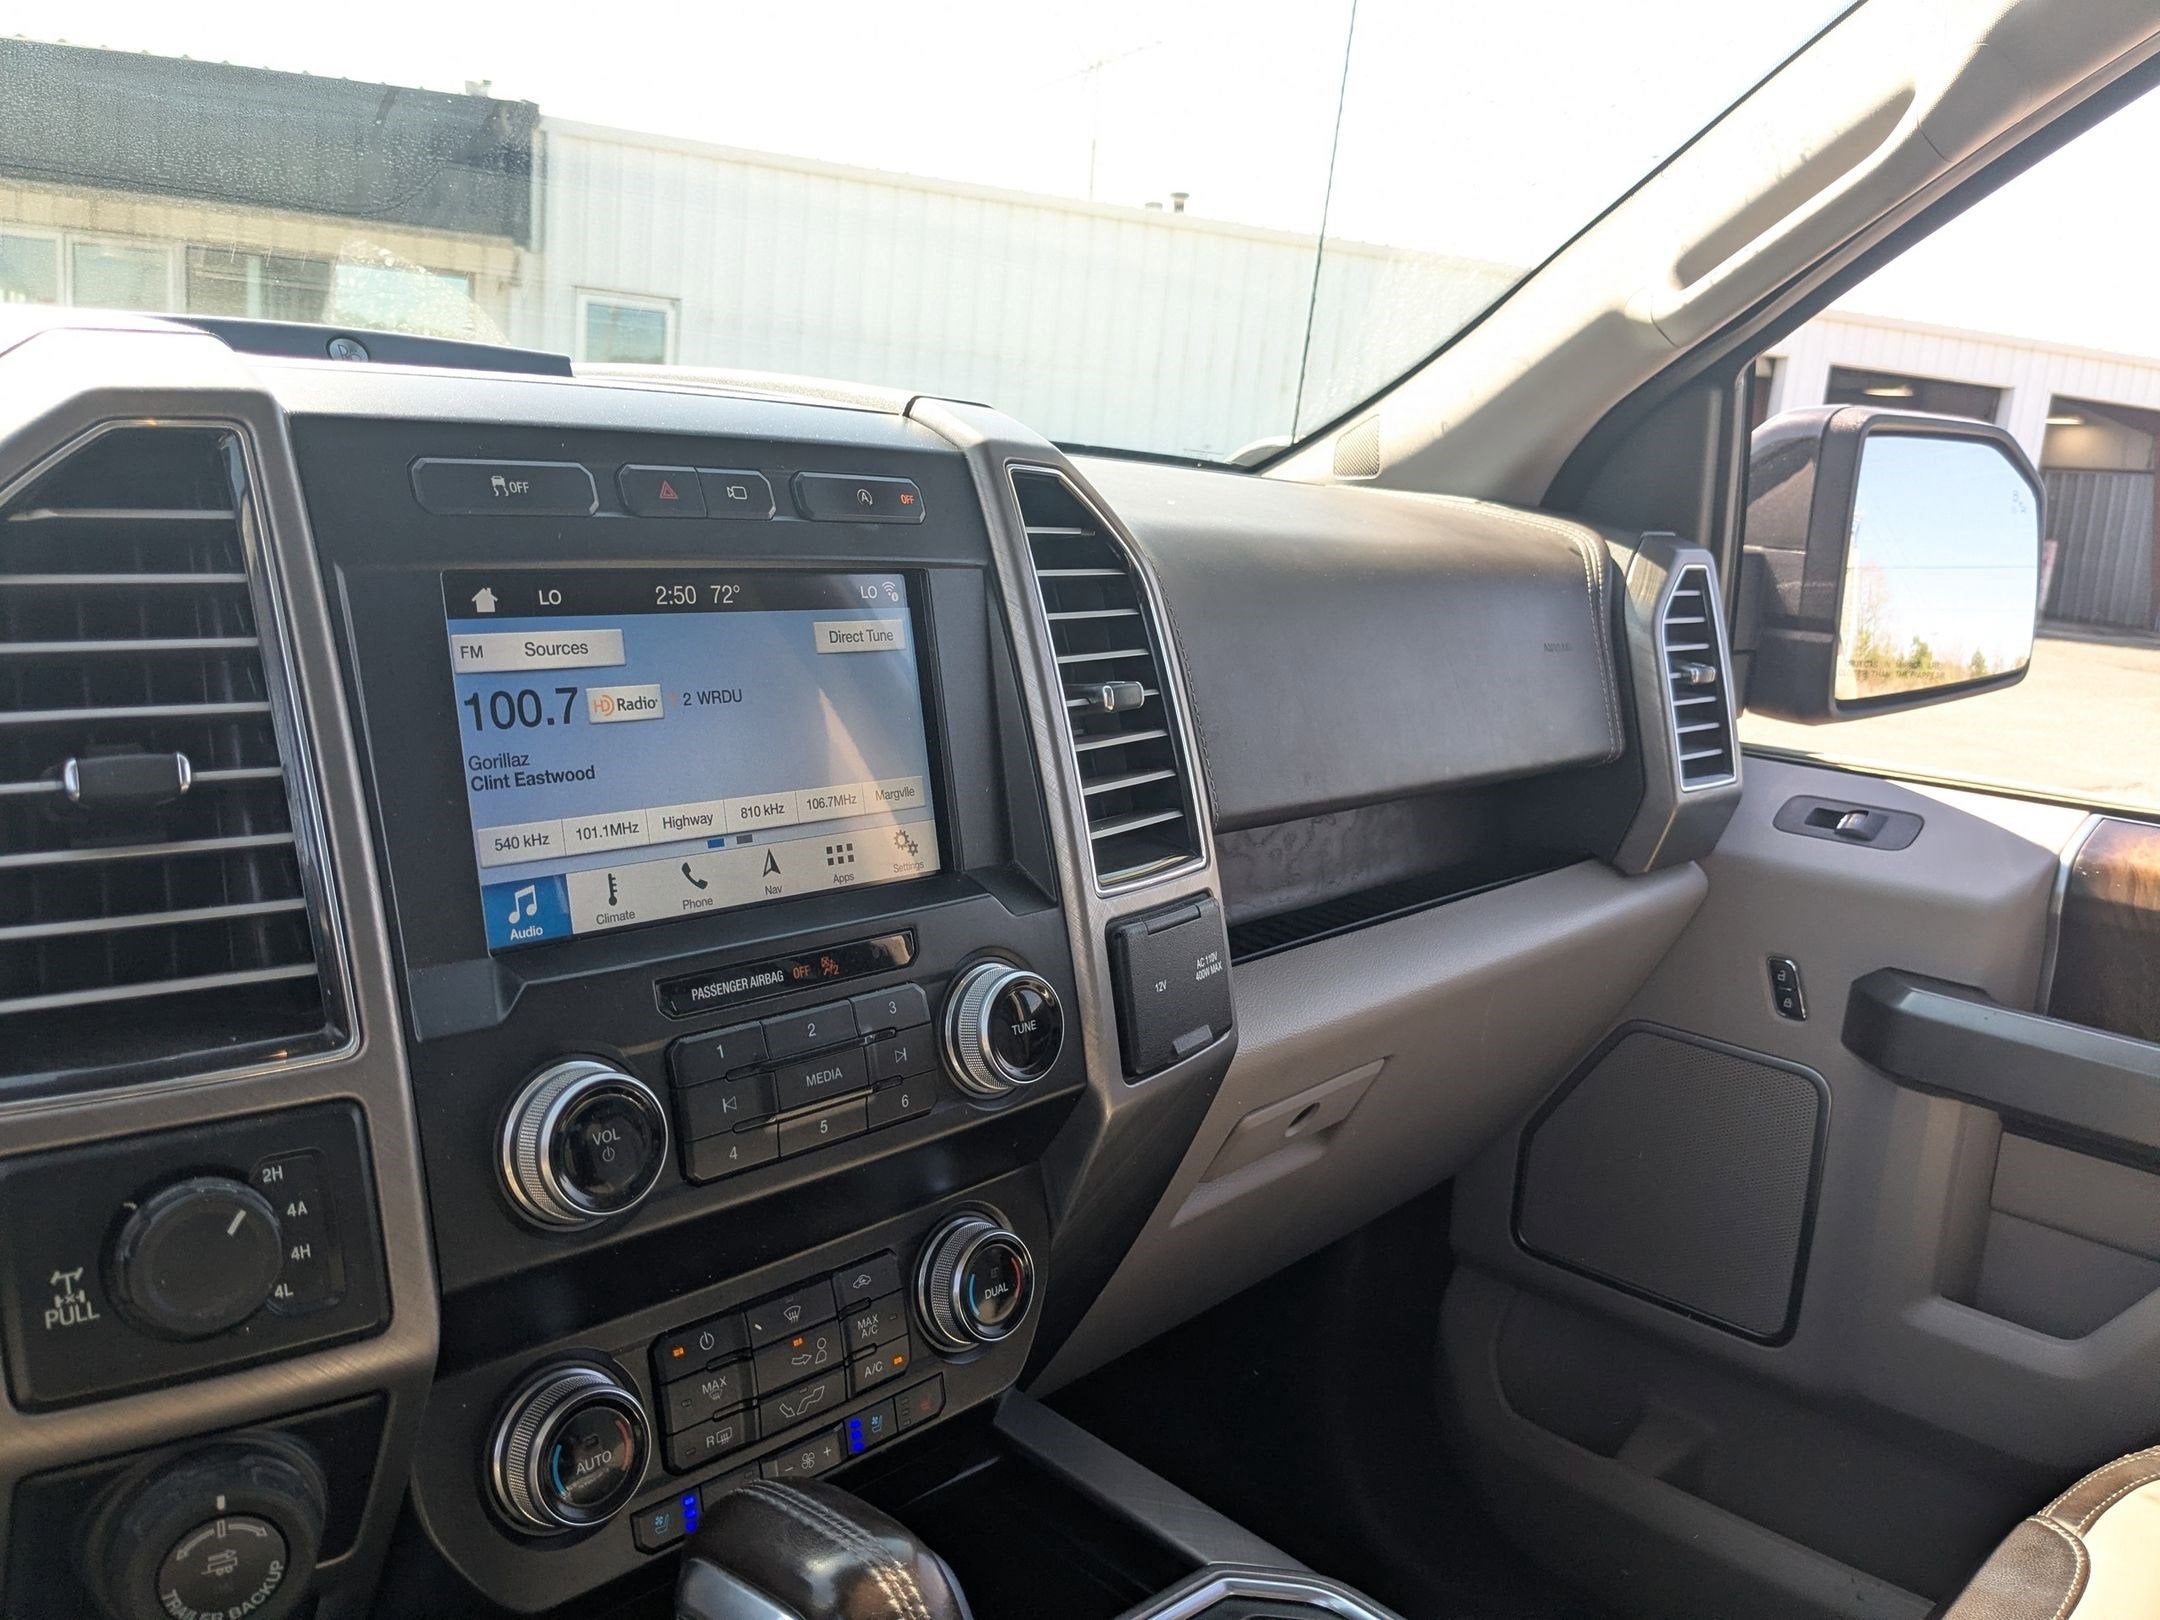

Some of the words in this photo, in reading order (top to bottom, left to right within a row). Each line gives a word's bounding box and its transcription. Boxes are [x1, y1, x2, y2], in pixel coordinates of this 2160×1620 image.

[509, 481, 529, 494] OFF
[900, 494, 914, 505] OFF
[538, 589, 562, 606] LO
[655, 585, 697, 605] 2:50
[710, 584, 740, 604] 72°
[860, 585, 878, 599] LO
[829, 630, 863, 644] Direct
[866, 629, 894, 643] Tune
[460, 645, 484, 659] FM
[524, 641, 589, 657] Sources
[617, 697, 656, 712] Radio
[682, 693, 692, 706] 2
[697, 689, 743, 705] WRDU
[464, 687, 578, 732] 100.7
[468, 753, 530, 771] Gorillaz
[471, 773, 511, 791] Clint
[514, 765, 596, 787] Eastwood
[740, 805, 761, 819] 810
[763, 802, 785, 816] kHz
[806, 794, 857, 811] 106.7MHz
[662, 813, 714, 830] Highway
[575, 821, 640, 841] 101.1MHz
[495, 837, 520, 851] 540
[524, 834, 550, 848] kHz
[893, 860, 924, 875] Settings
[832, 873, 855, 885] Apps
[765, 885, 783, 895] Nav
[682, 897, 713, 910] Phone
[596, 910, 636, 925] Climate
[510, 925, 543, 941] Audio
[1196, 957, 1205, 970] AC
[1196, 966, 1210, 981] 400W
[1210, 960, 1223, 974] MAX
[691, 978, 749, 1001] PASSENGER
[750, 970, 784, 988] AIRBAG
[793, 965, 811, 979] OFF
[1155, 979, 1167, 993] 12V
[888, 1001, 897, 1014] 3
[807, 1024, 817, 1037] 2
[1011, 1019, 1038, 1036] TUNE
[716, 1044, 724, 1059] 1
[806, 1067, 843, 1088] MEDIA
[901, 1094, 910, 1108] 6
[820, 1120, 828, 1134] 5
[592, 1128, 621, 1146] VOL
[729, 1147, 738, 1160] 4
[262, 1166, 283, 1183] 2H
[286, 1202, 308, 1217] 4A
[290, 1244, 311, 1260] 4H
[274, 1284, 294, 1299] 4L
[984, 1282, 1009, 1300] DUAL
[45, 1303, 100, 1330] PULL
[857, 1313, 879, 1330] MAX
[861, 1324, 878, 1339] A/C
[864, 1361, 883, 1378] A/C
[702, 1376, 727, 1394] MAX
[706, 1435, 715, 1448] R
[576, 1450, 612, 1475] AUTO
[229, 1560, 284, 1619] BACKUP
